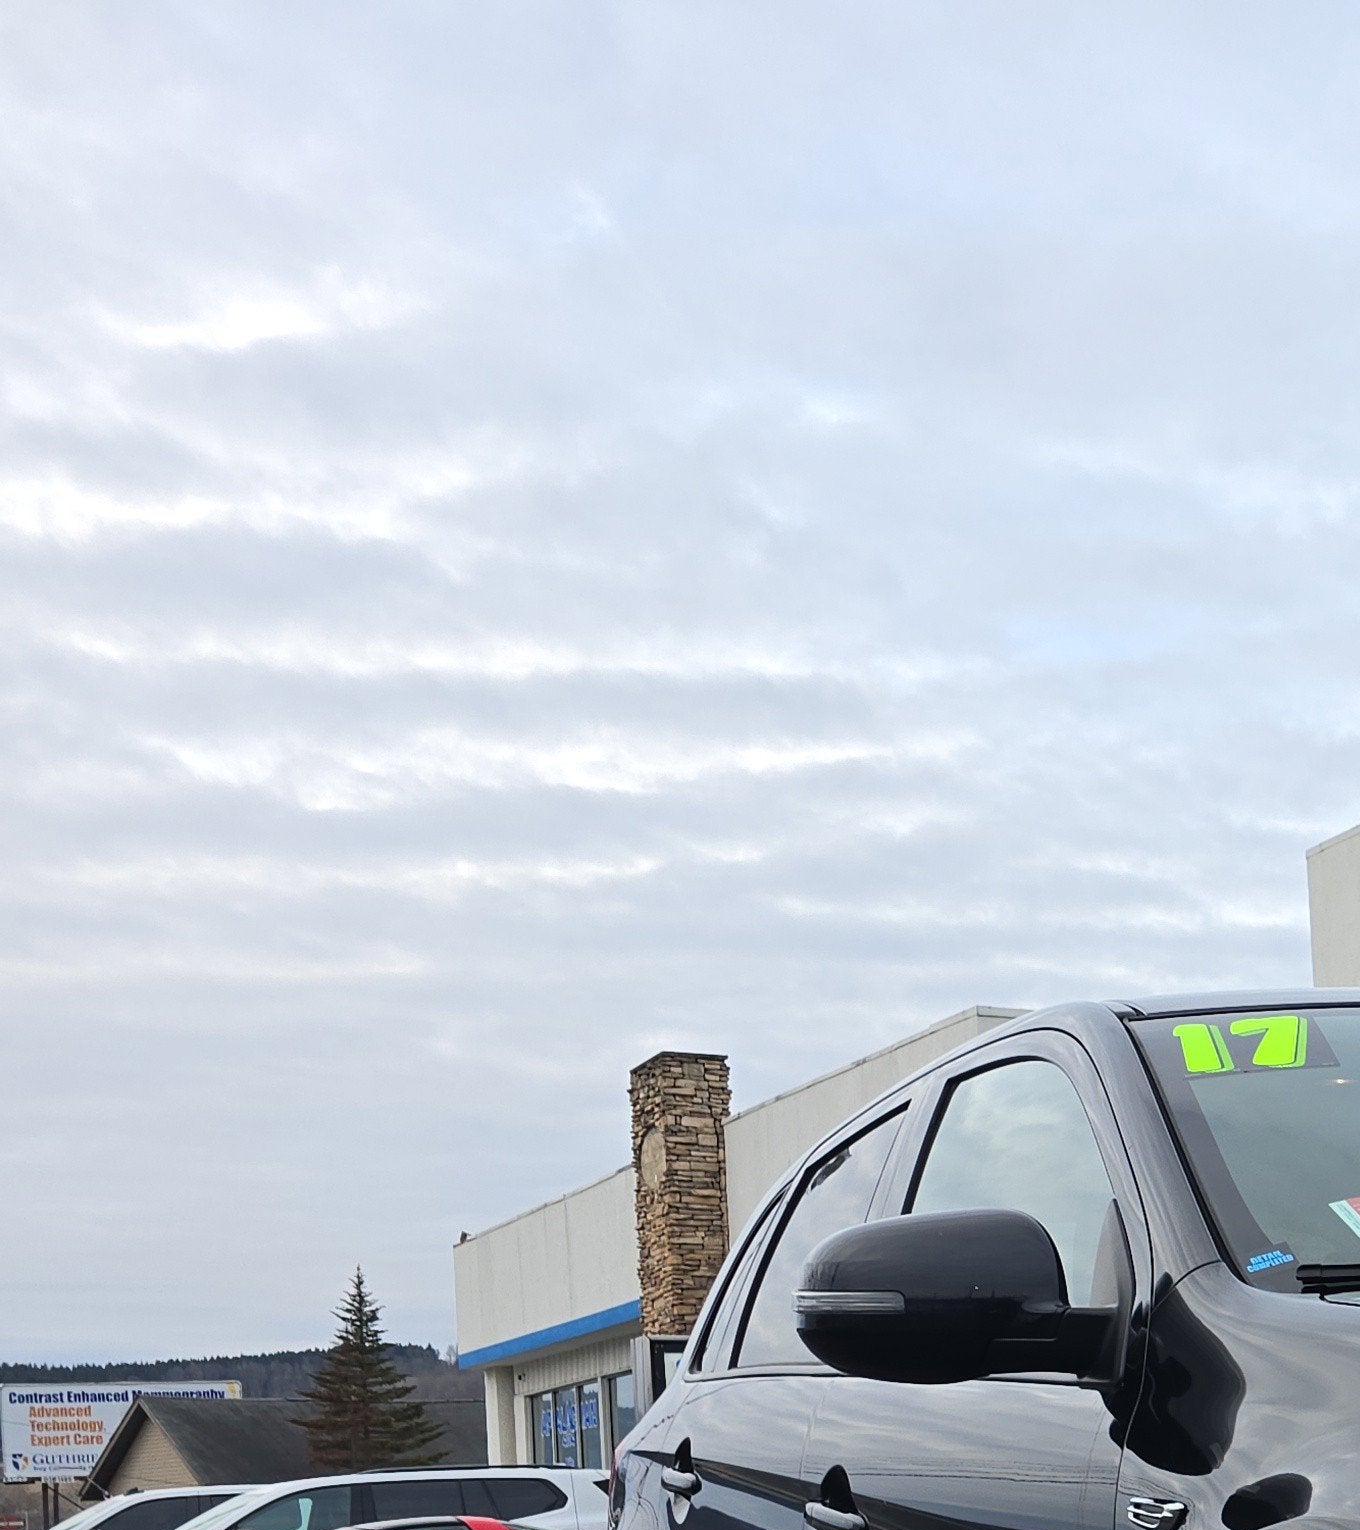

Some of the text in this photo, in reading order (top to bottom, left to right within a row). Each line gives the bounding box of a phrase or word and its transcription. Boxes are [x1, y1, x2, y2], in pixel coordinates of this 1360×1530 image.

[1172, 1015, 1308, 1074] 17
[8, 1391, 65, 1404] Contrast
[67, 1390, 129, 1403] Enhanced
[29, 1405, 92, 1418] Advanced
[30, 1433, 103, 1446] Expert Care
